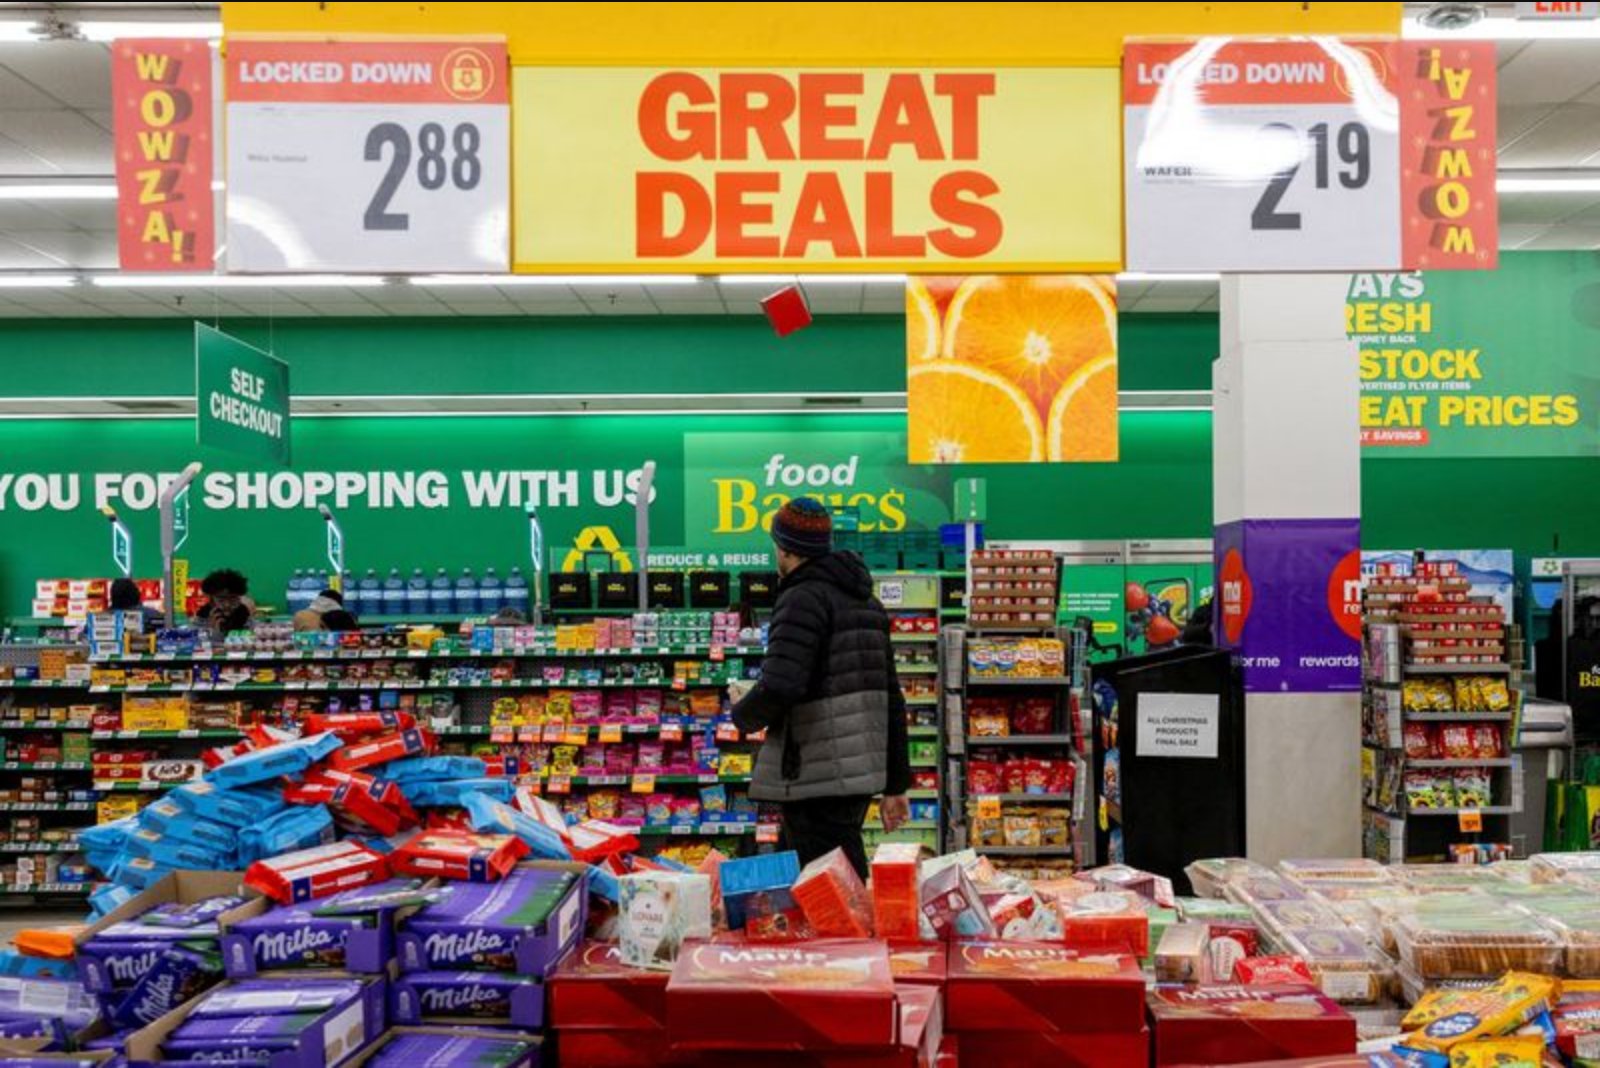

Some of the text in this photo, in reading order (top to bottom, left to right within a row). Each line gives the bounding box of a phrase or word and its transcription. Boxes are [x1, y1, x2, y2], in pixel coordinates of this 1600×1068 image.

[239, 61, 433, 84] LOCKED DOWN
[1137, 62, 1325, 84] LOED DOWN
[636, 71, 996, 161] GREAT
[136, 53, 191, 262] WOWZA!
[635, 170, 1004, 259] DEALS
[1360, 349, 1483, 381] STOCK
[230, 366, 266, 402] SELF
[209, 391, 283, 439] CHECKOUT
[1438, 395, 1580, 427] PRICES
[764, 453, 859, 487] food
[203, 470, 449, 510] SHOPPING
[462, 470, 580, 508] WITH
[647, 553, 769, 568] REDUCE & REUSE
[1256, 656, 1280, 668] me
[1299, 653, 1360, 668] rewards
[1155, 727, 1199, 736] PRODUCTS
[1161, 715, 1209, 725] CHRISTMAS
[1155, 738, 1198, 747] FINAL SALE
[253, 926, 333, 962] Milka
[425, 928, 505, 962] Milka
[133, 972, 176, 1023] Milka
[420, 984, 501, 1011] Milka
